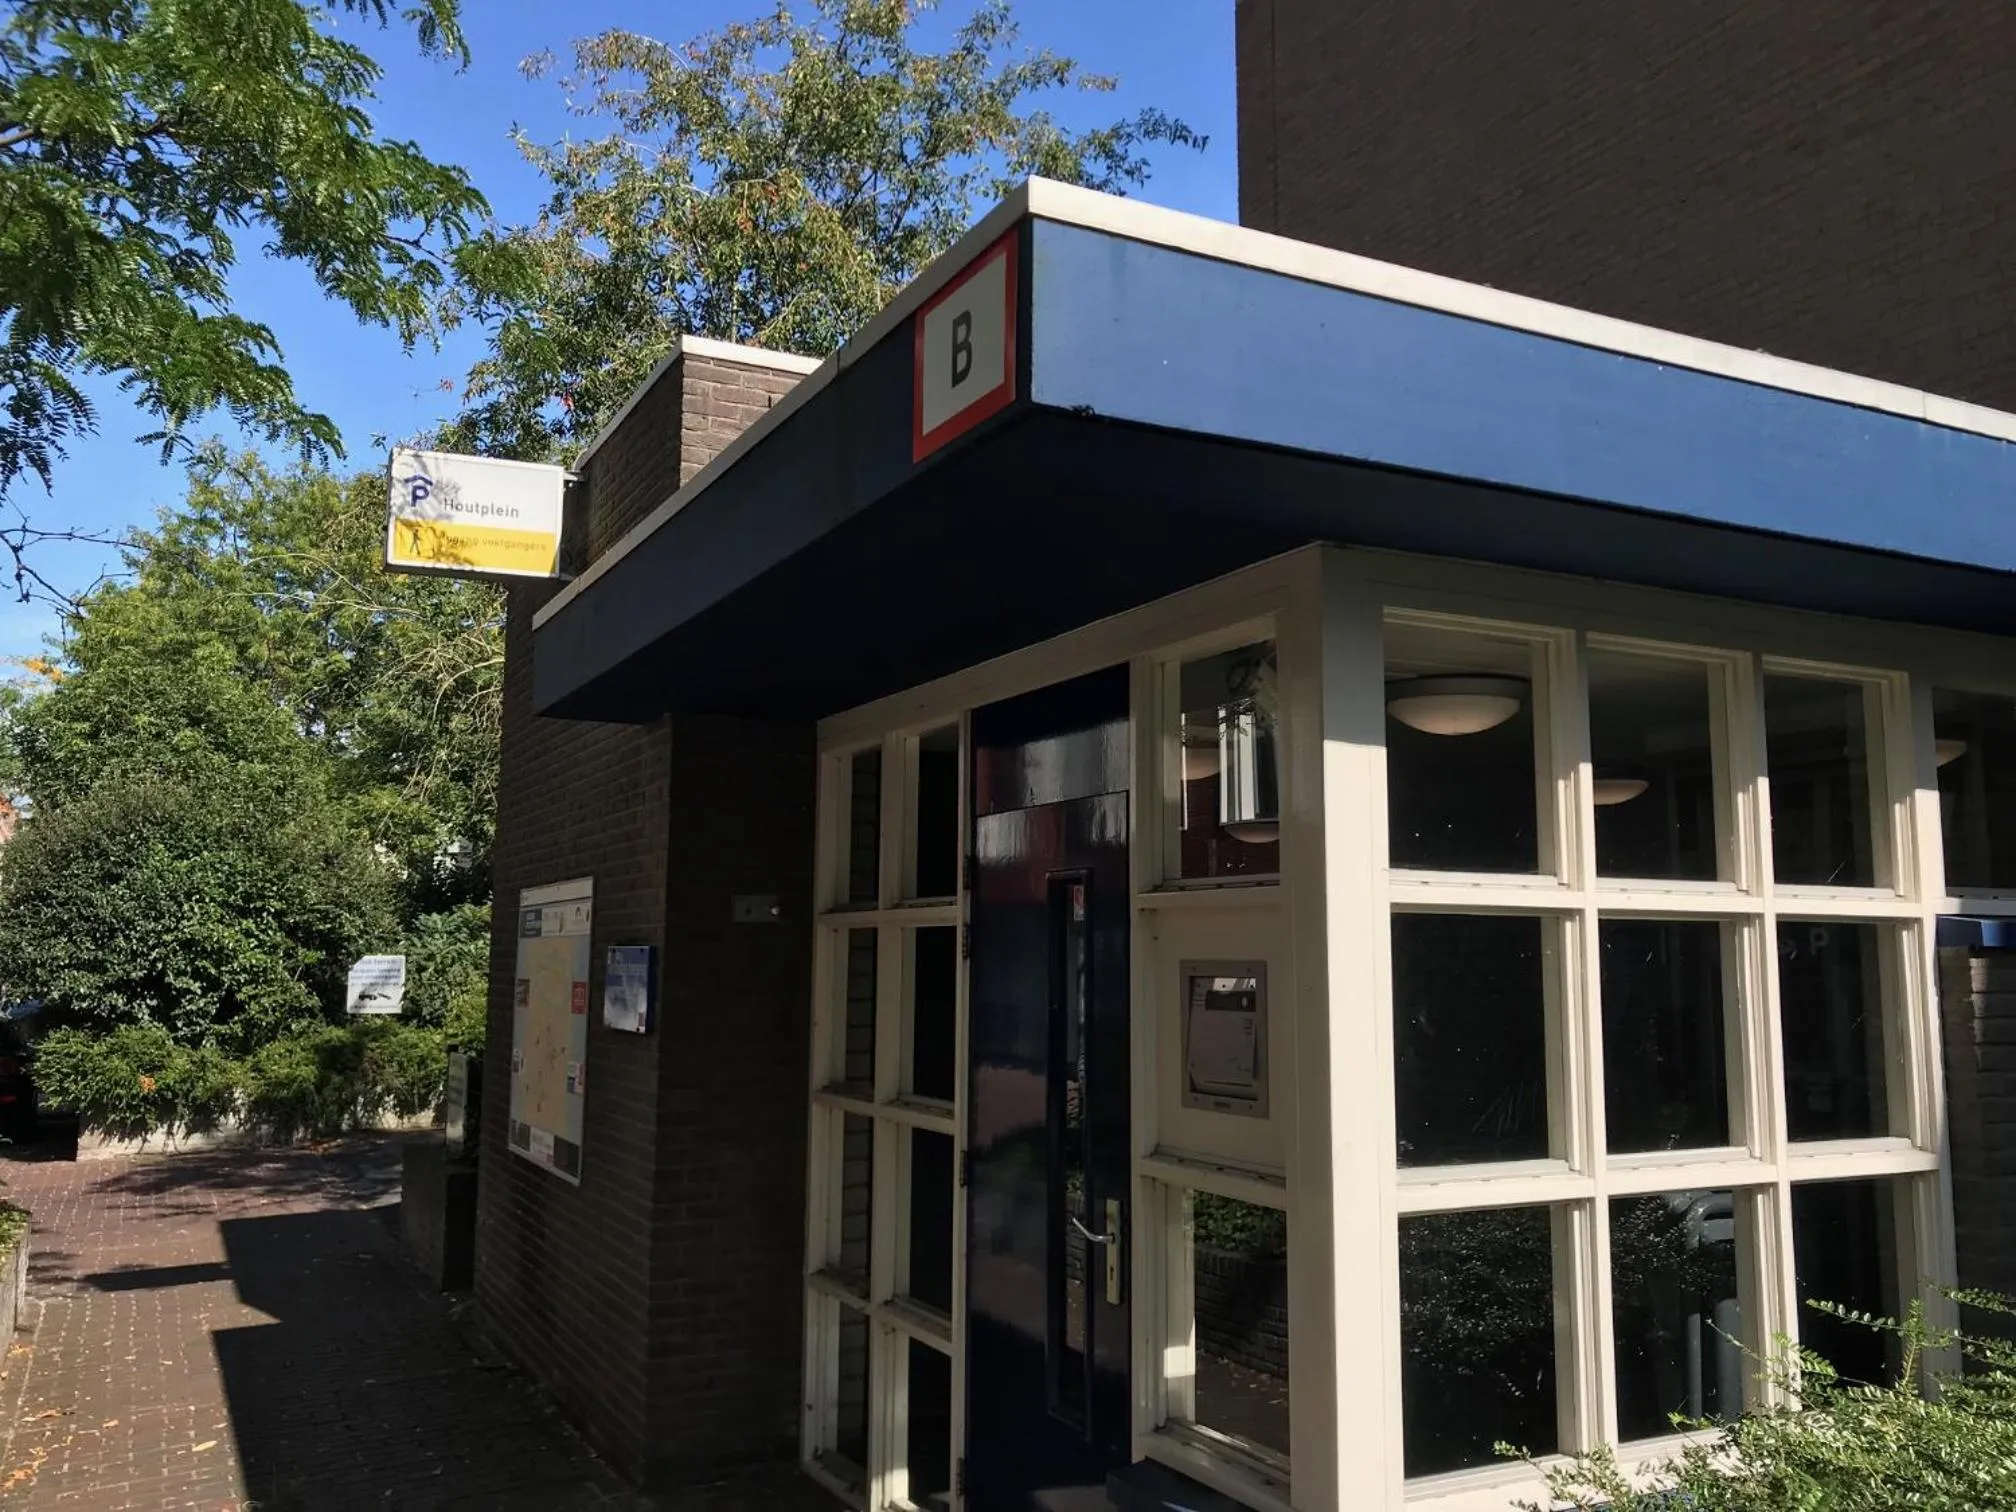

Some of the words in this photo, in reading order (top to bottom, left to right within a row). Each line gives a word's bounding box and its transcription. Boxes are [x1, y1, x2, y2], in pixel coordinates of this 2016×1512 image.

[951, 309, 973, 389] B
[411, 485, 430, 508] P
[444, 498, 520, 519] Houtplein
